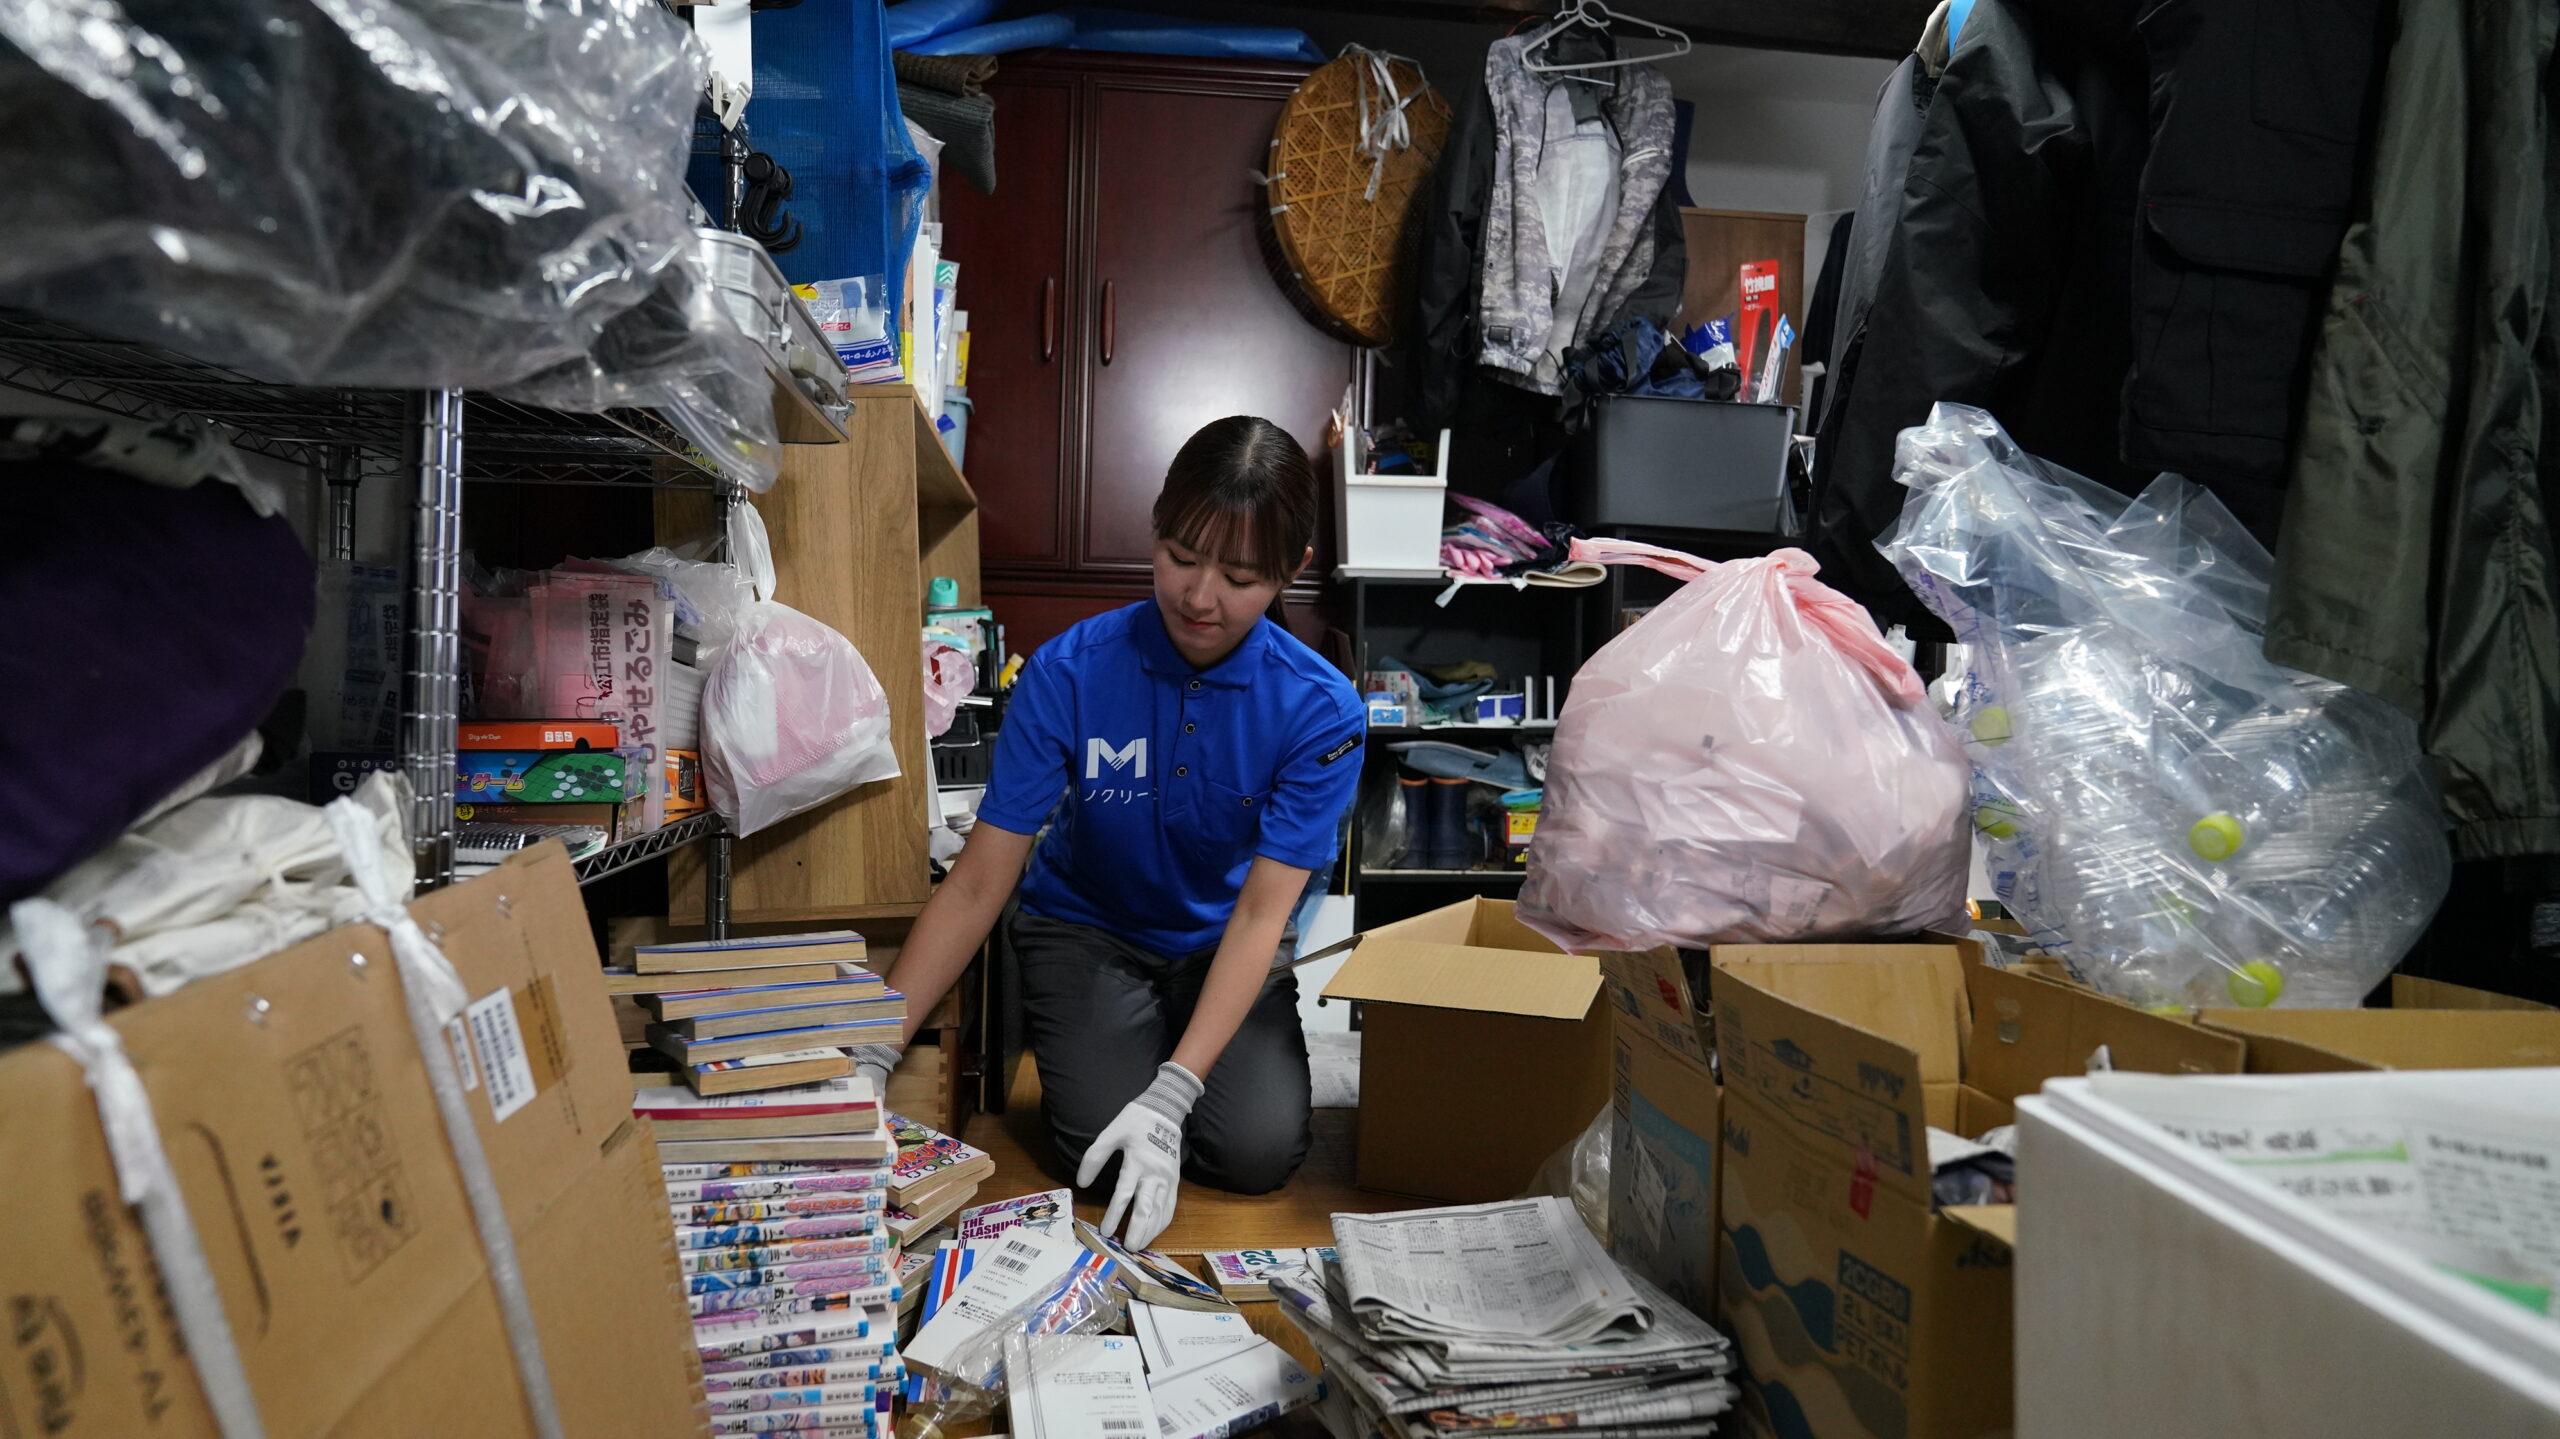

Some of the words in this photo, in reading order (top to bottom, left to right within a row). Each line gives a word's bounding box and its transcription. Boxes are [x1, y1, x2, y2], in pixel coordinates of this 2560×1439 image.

[1085, 737, 1147, 778] M
[471, 773, 525, 792] ゲーム
[963, 1217, 984, 1229] THE
[1241, 1250, 1280, 1265] 22
